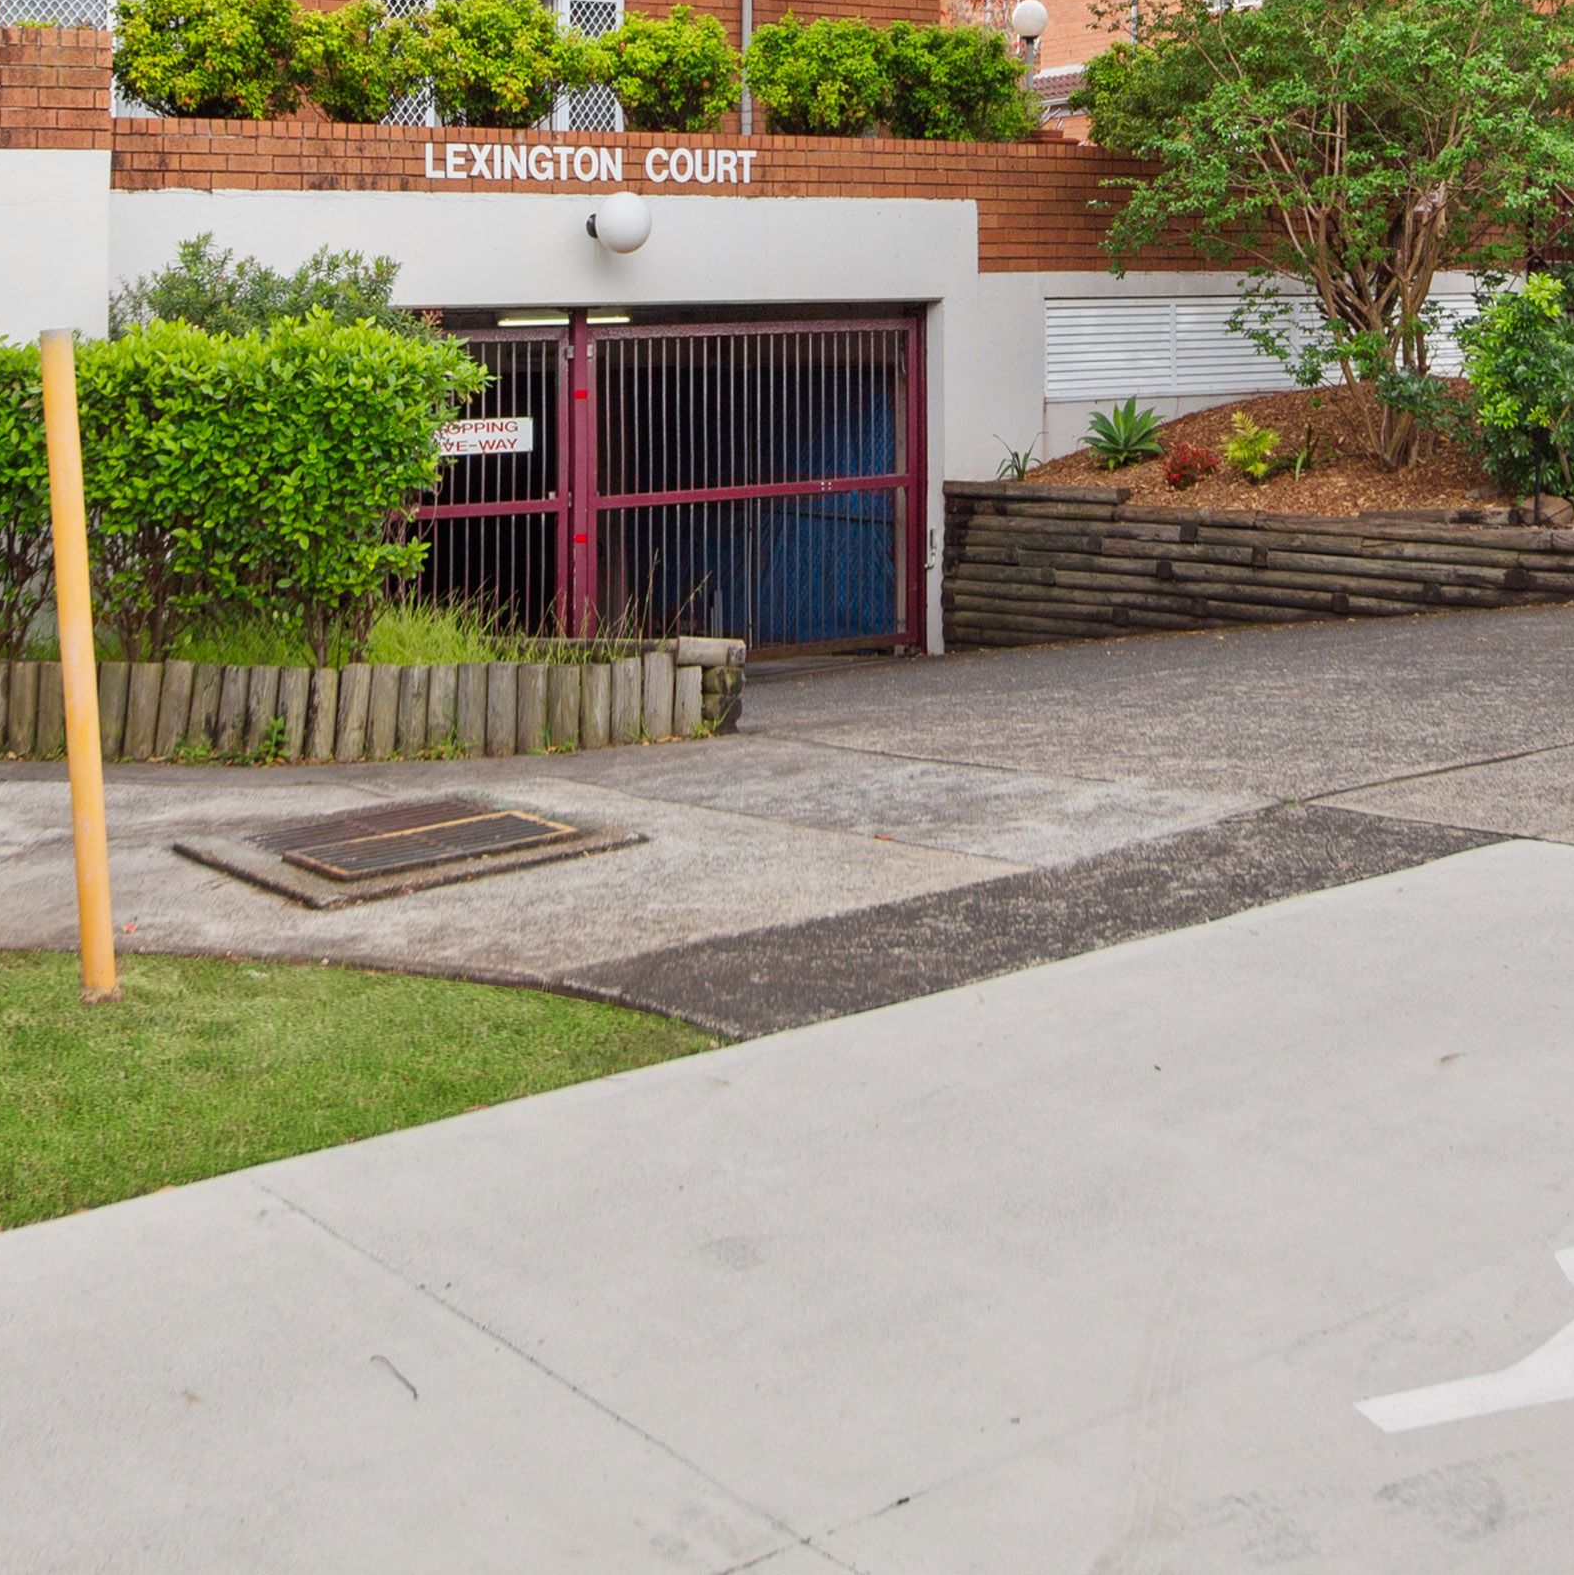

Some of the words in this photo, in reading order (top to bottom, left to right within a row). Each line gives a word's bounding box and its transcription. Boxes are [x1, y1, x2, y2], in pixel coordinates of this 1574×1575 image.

[425, 142, 623, 182] LEXINGTON
[645, 147, 757, 184] COURT
[437, 421, 519, 435] OPPING
